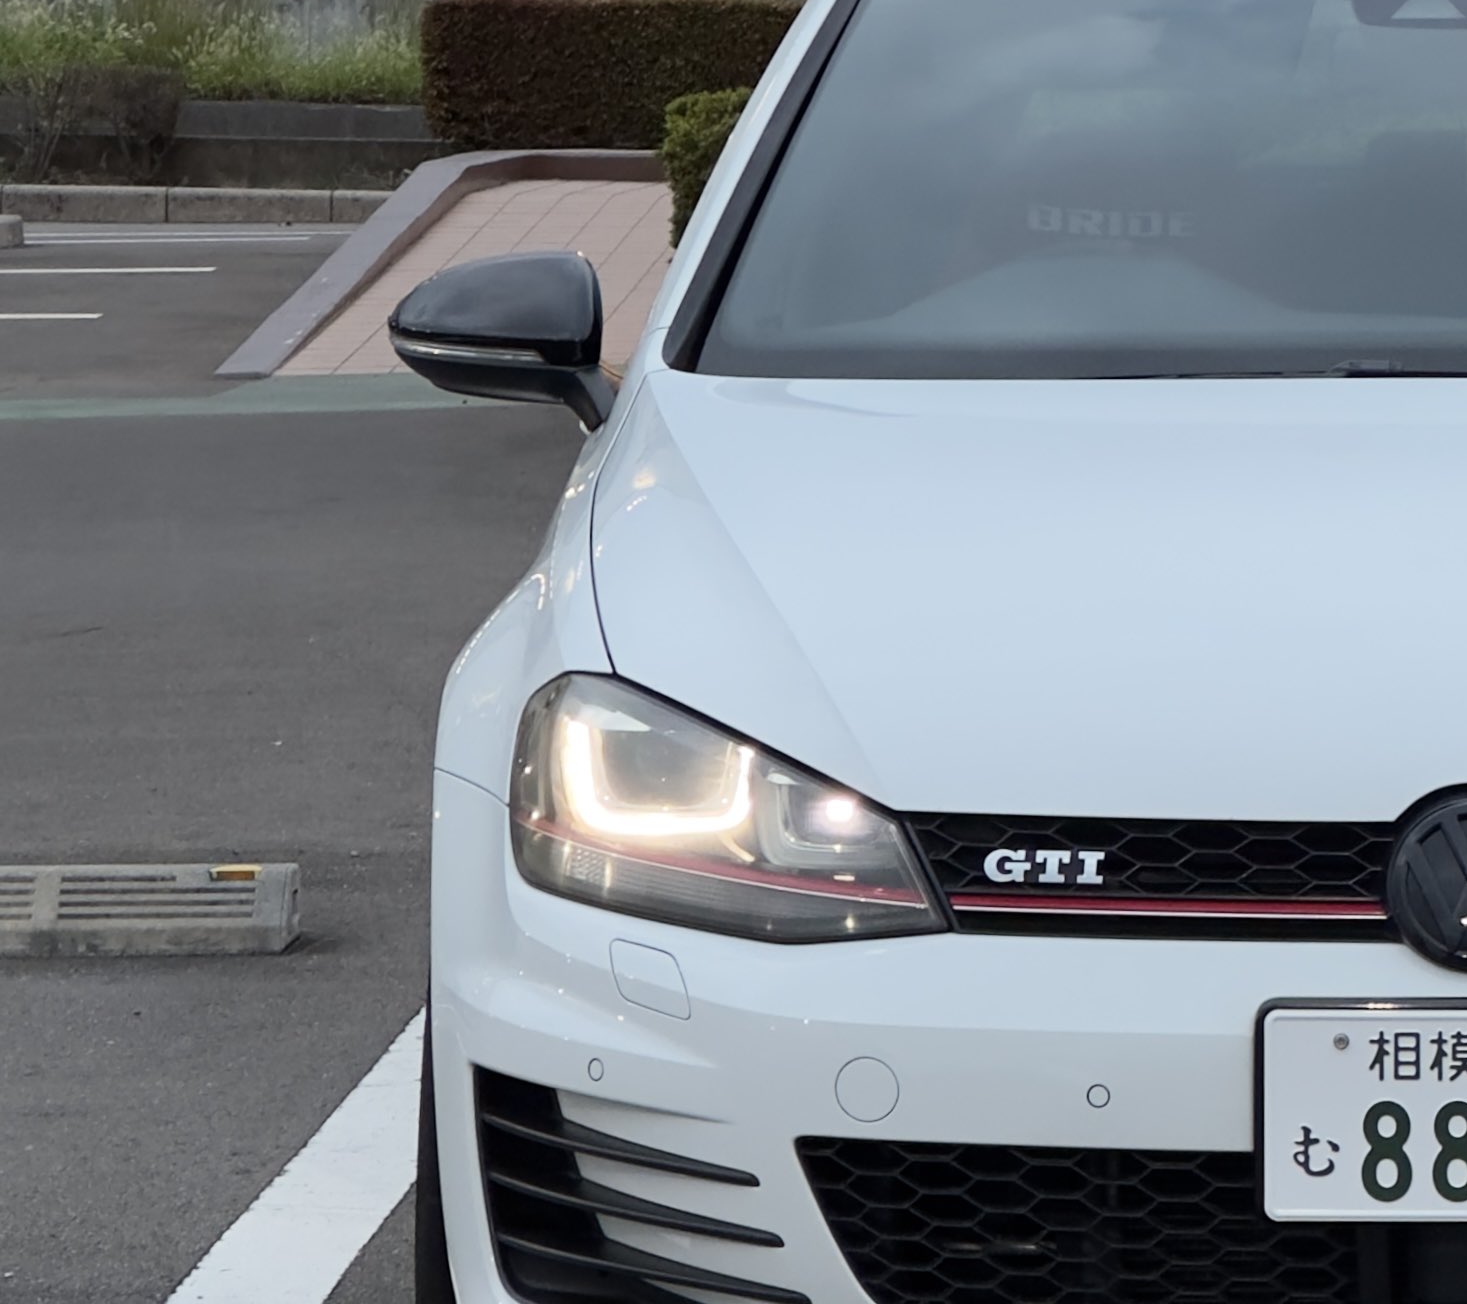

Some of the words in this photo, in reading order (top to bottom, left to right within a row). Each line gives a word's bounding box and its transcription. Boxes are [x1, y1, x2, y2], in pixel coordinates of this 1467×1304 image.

[1027, 204, 1196, 237] BRIDE
[983, 848, 1105, 884] GTI
[1292, 1125, 1340, 1177] む
